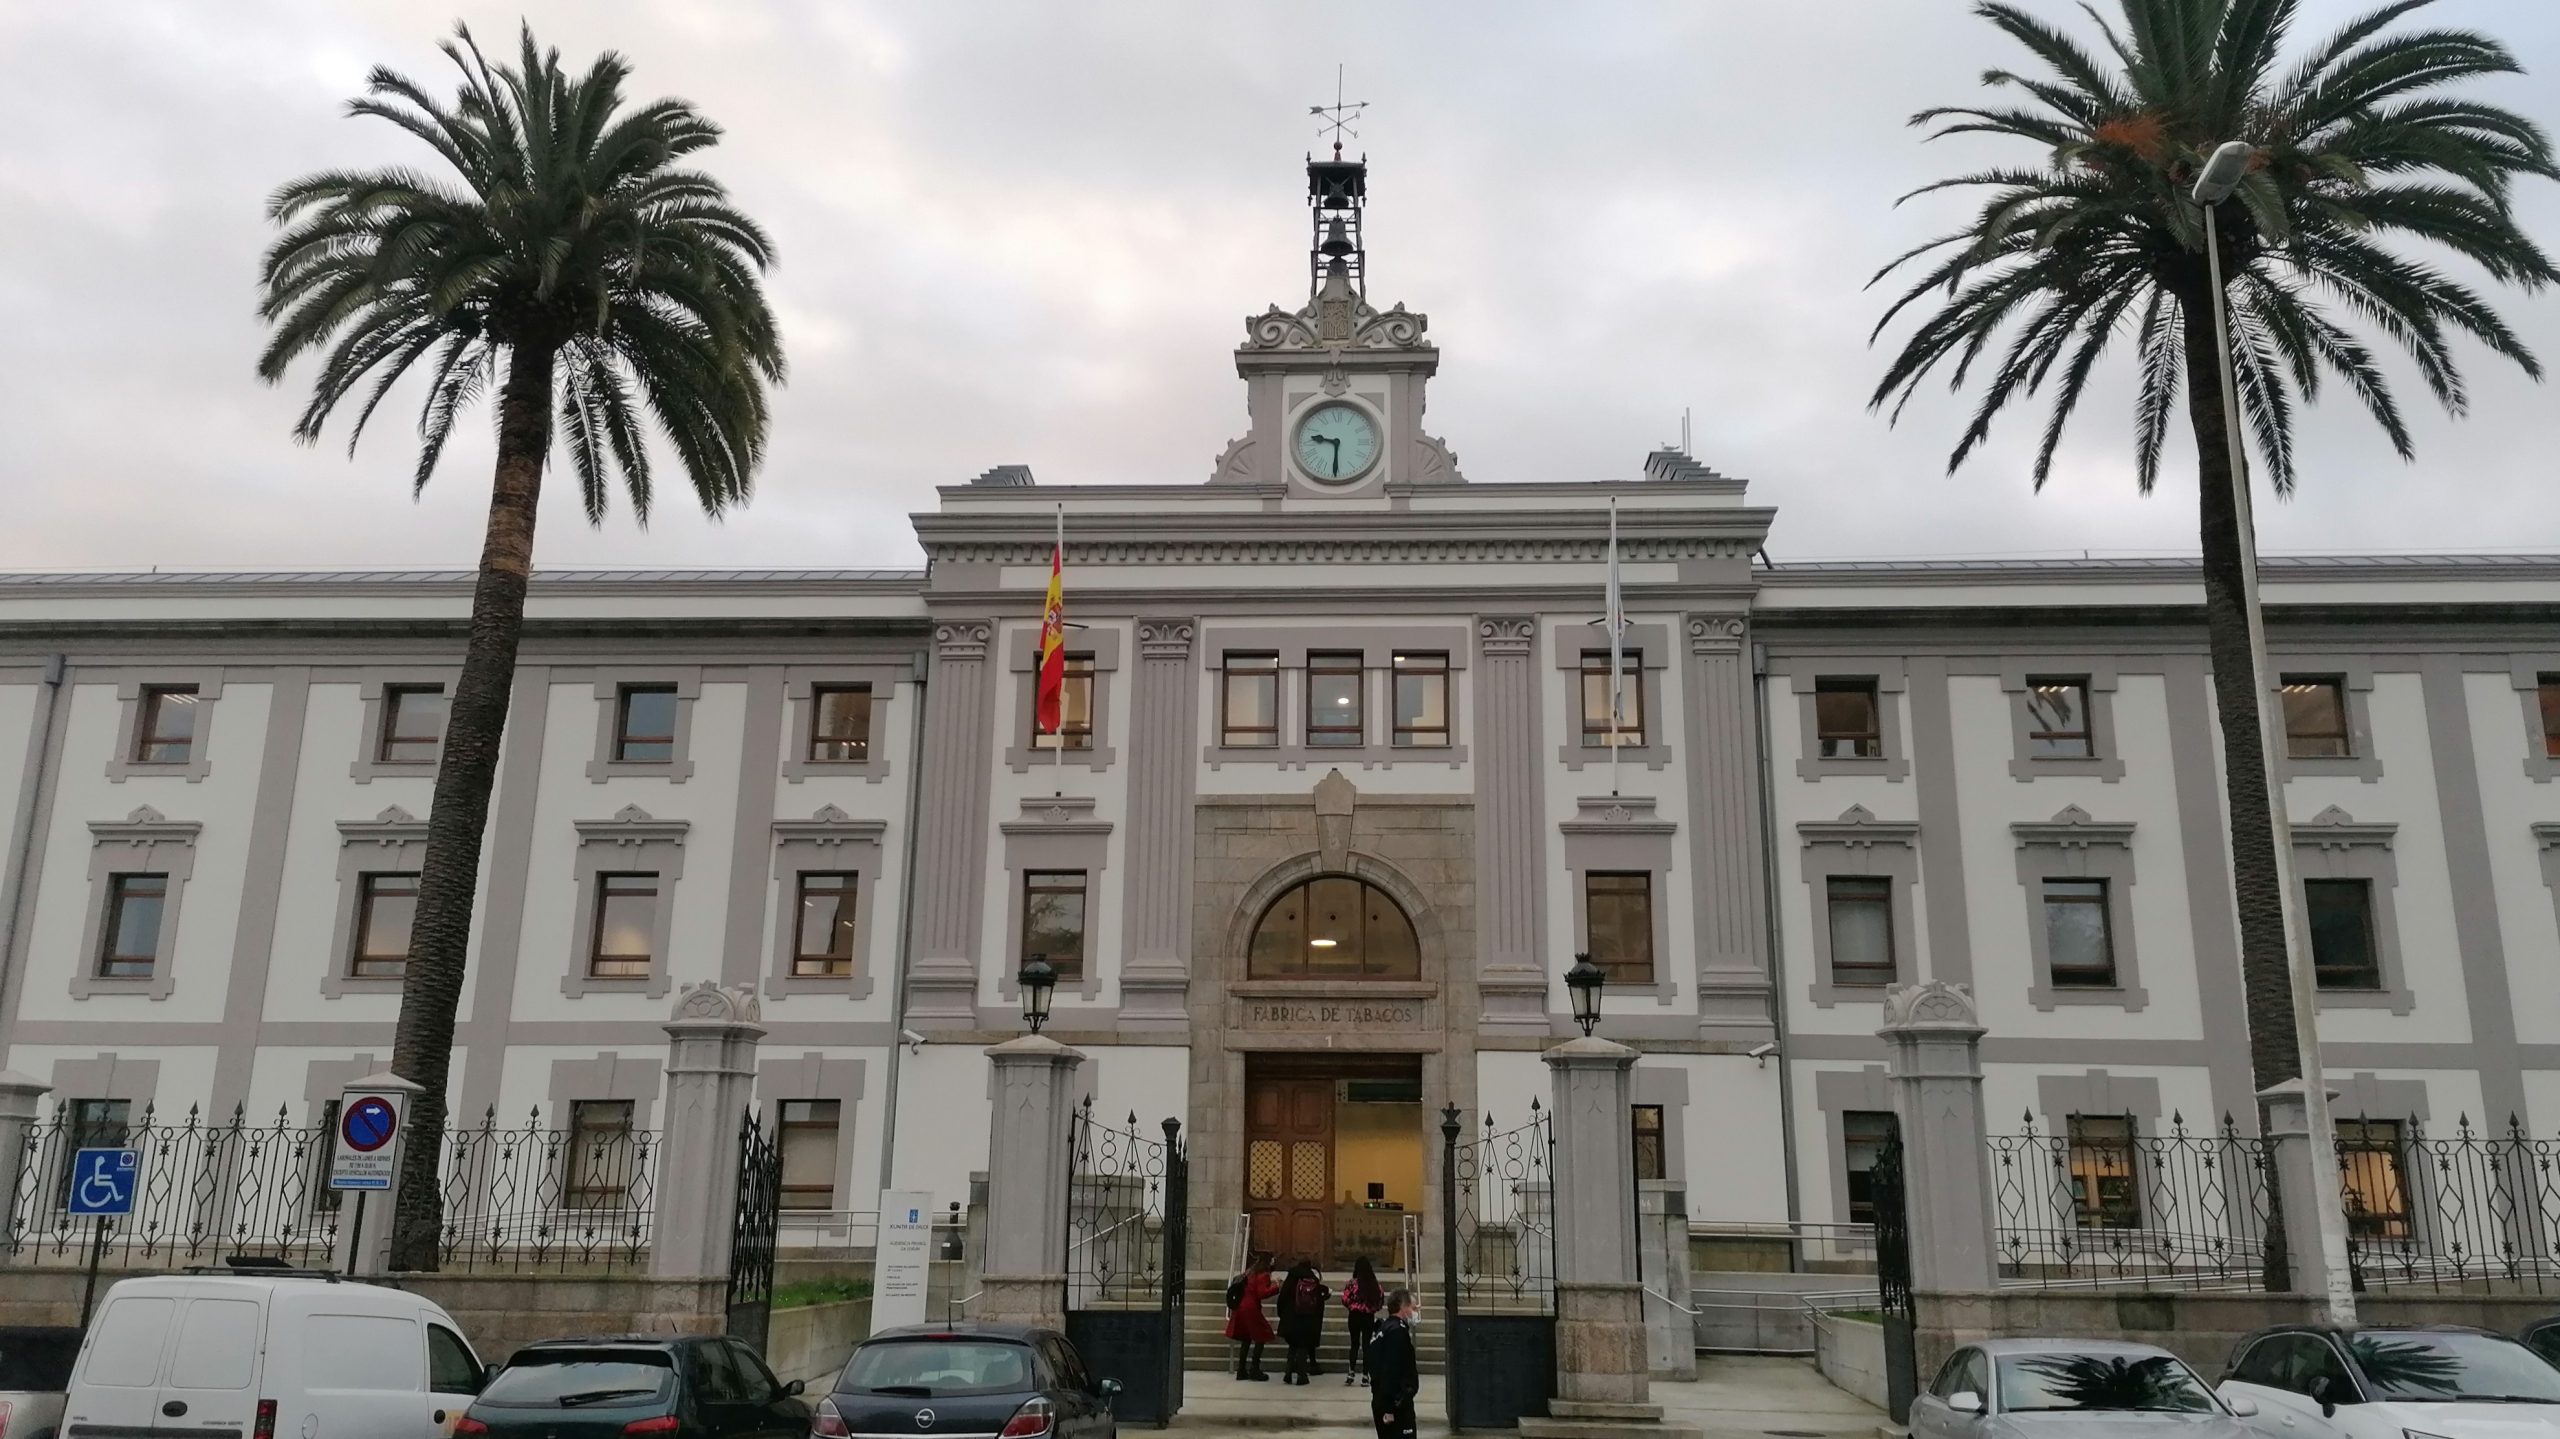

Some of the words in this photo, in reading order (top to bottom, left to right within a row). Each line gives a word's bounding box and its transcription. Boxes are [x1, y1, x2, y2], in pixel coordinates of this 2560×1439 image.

[1253, 1006, 1315, 1022] FABRICA
[1321, 1006, 1340, 1022] DE
[1346, 1006, 1413, 1024] TABACOS
[1325, 1035, 1332, 1048] 1
